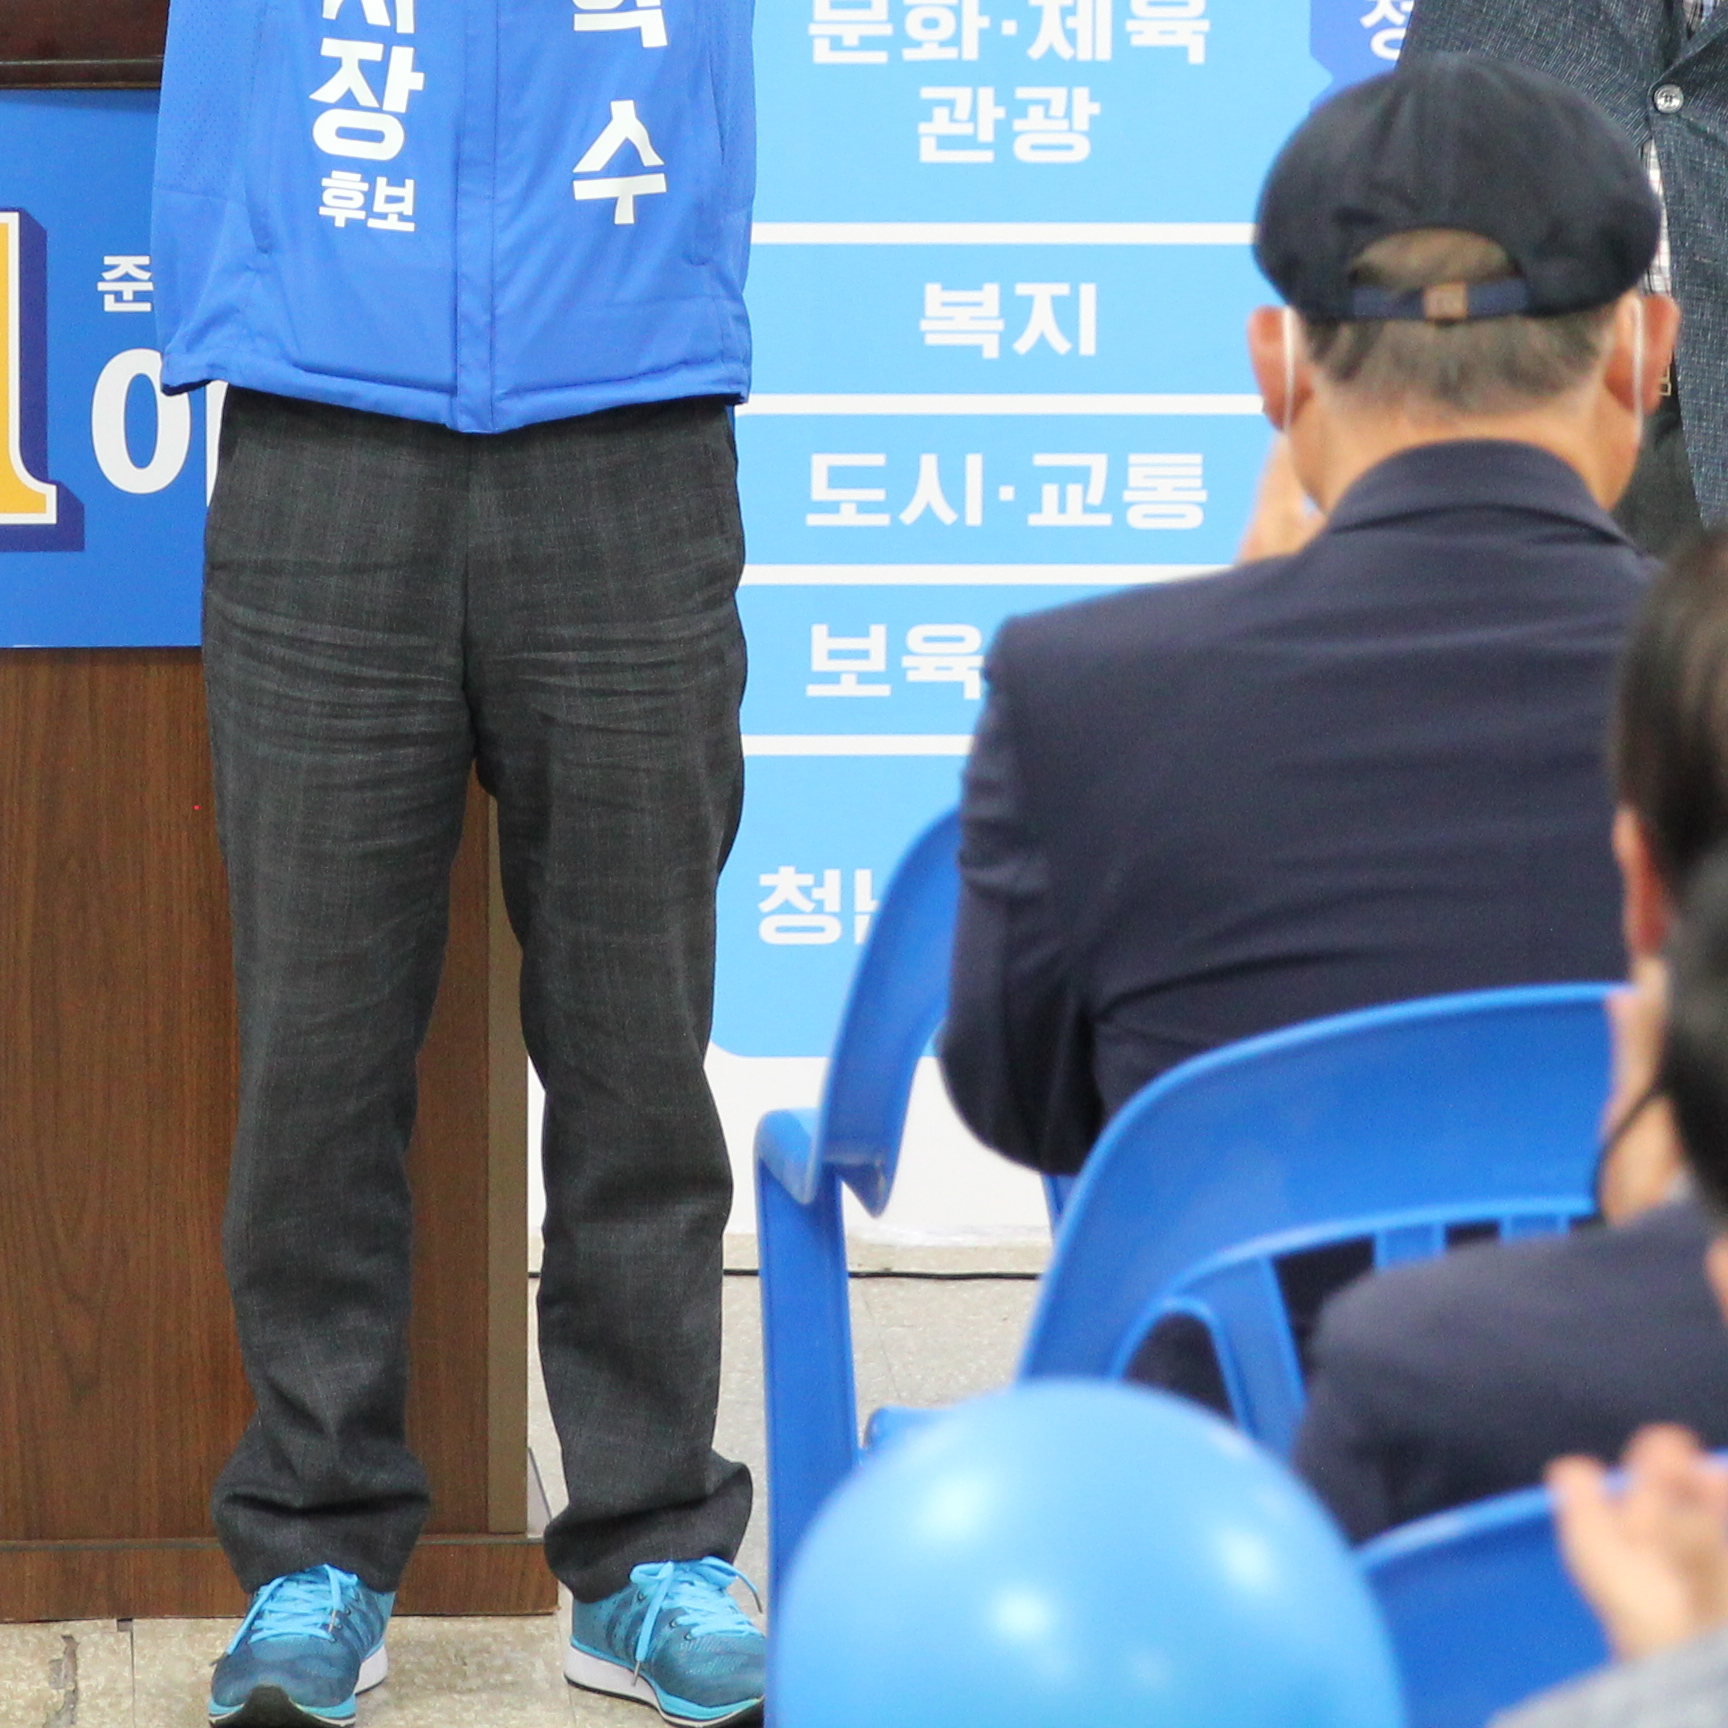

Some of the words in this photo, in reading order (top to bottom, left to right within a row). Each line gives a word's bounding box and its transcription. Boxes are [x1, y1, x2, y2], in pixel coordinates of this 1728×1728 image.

[917, 86, 1101, 164] 관광
[317, 170, 416, 232] 후보
[919, 282, 1097, 360] 복지
[805, 452, 1208, 529] 도시·교통
[806, 624, 984, 700] 보육
